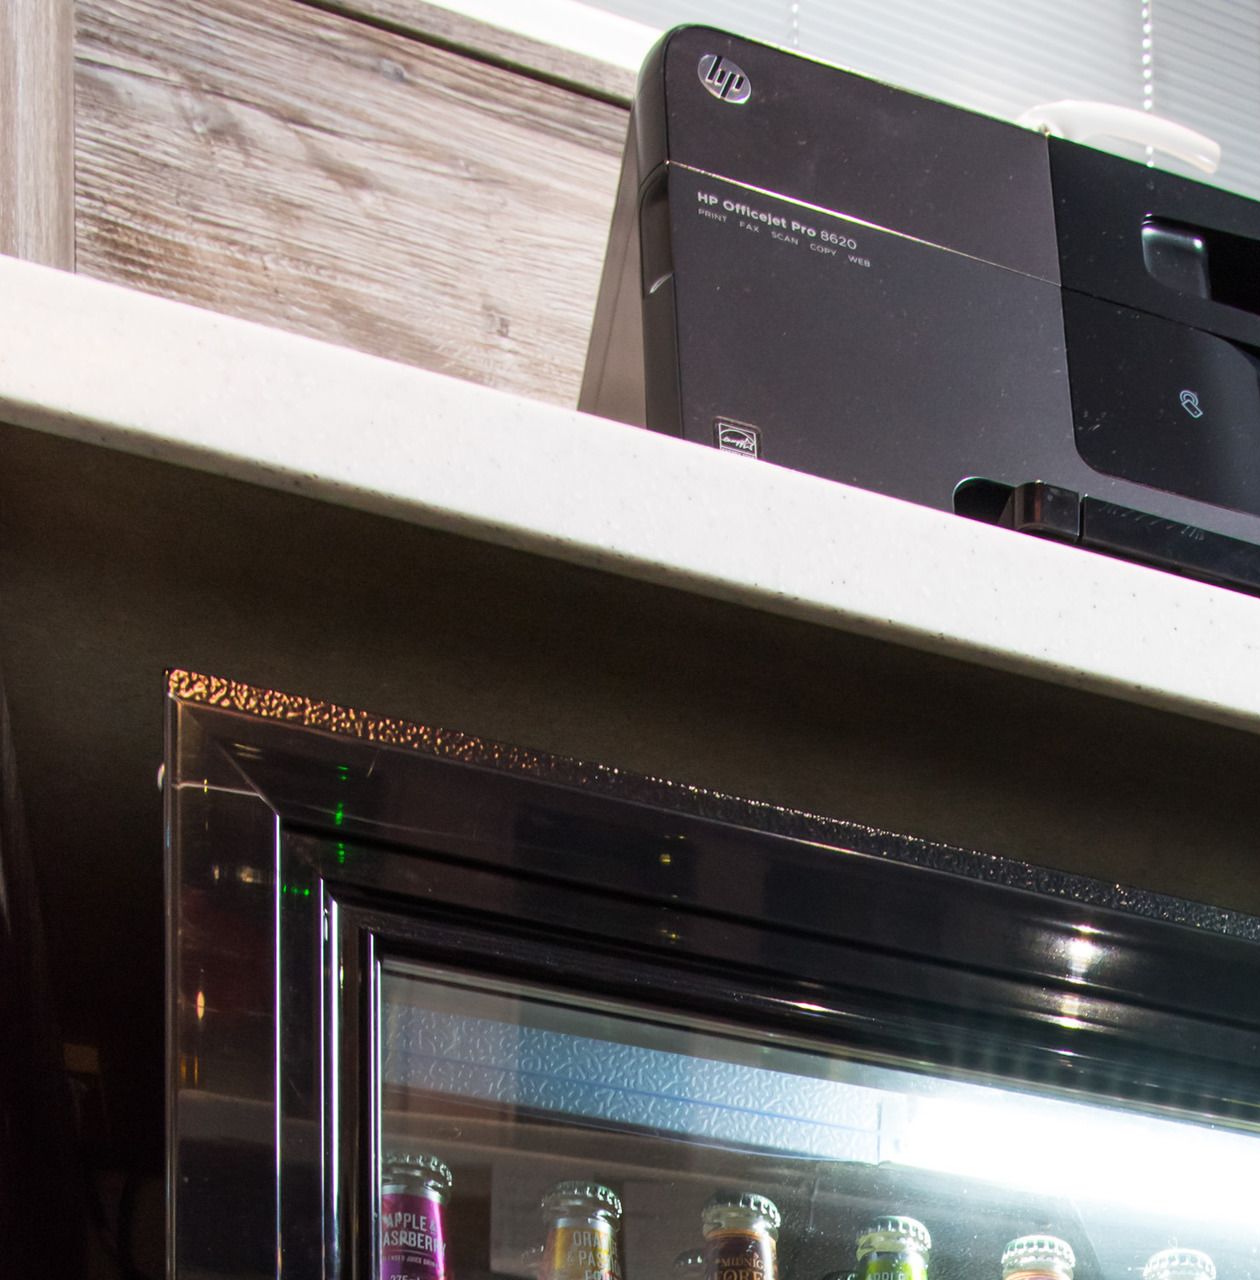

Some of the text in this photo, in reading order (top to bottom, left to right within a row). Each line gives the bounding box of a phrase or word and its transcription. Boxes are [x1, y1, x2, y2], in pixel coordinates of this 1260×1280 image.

[702, 55, 748, 100] hp
[697, 191, 857, 251] HP Officejet Pro 8620
[698, 208, 871, 268] PRINT FAX SCAN COPY WEB
